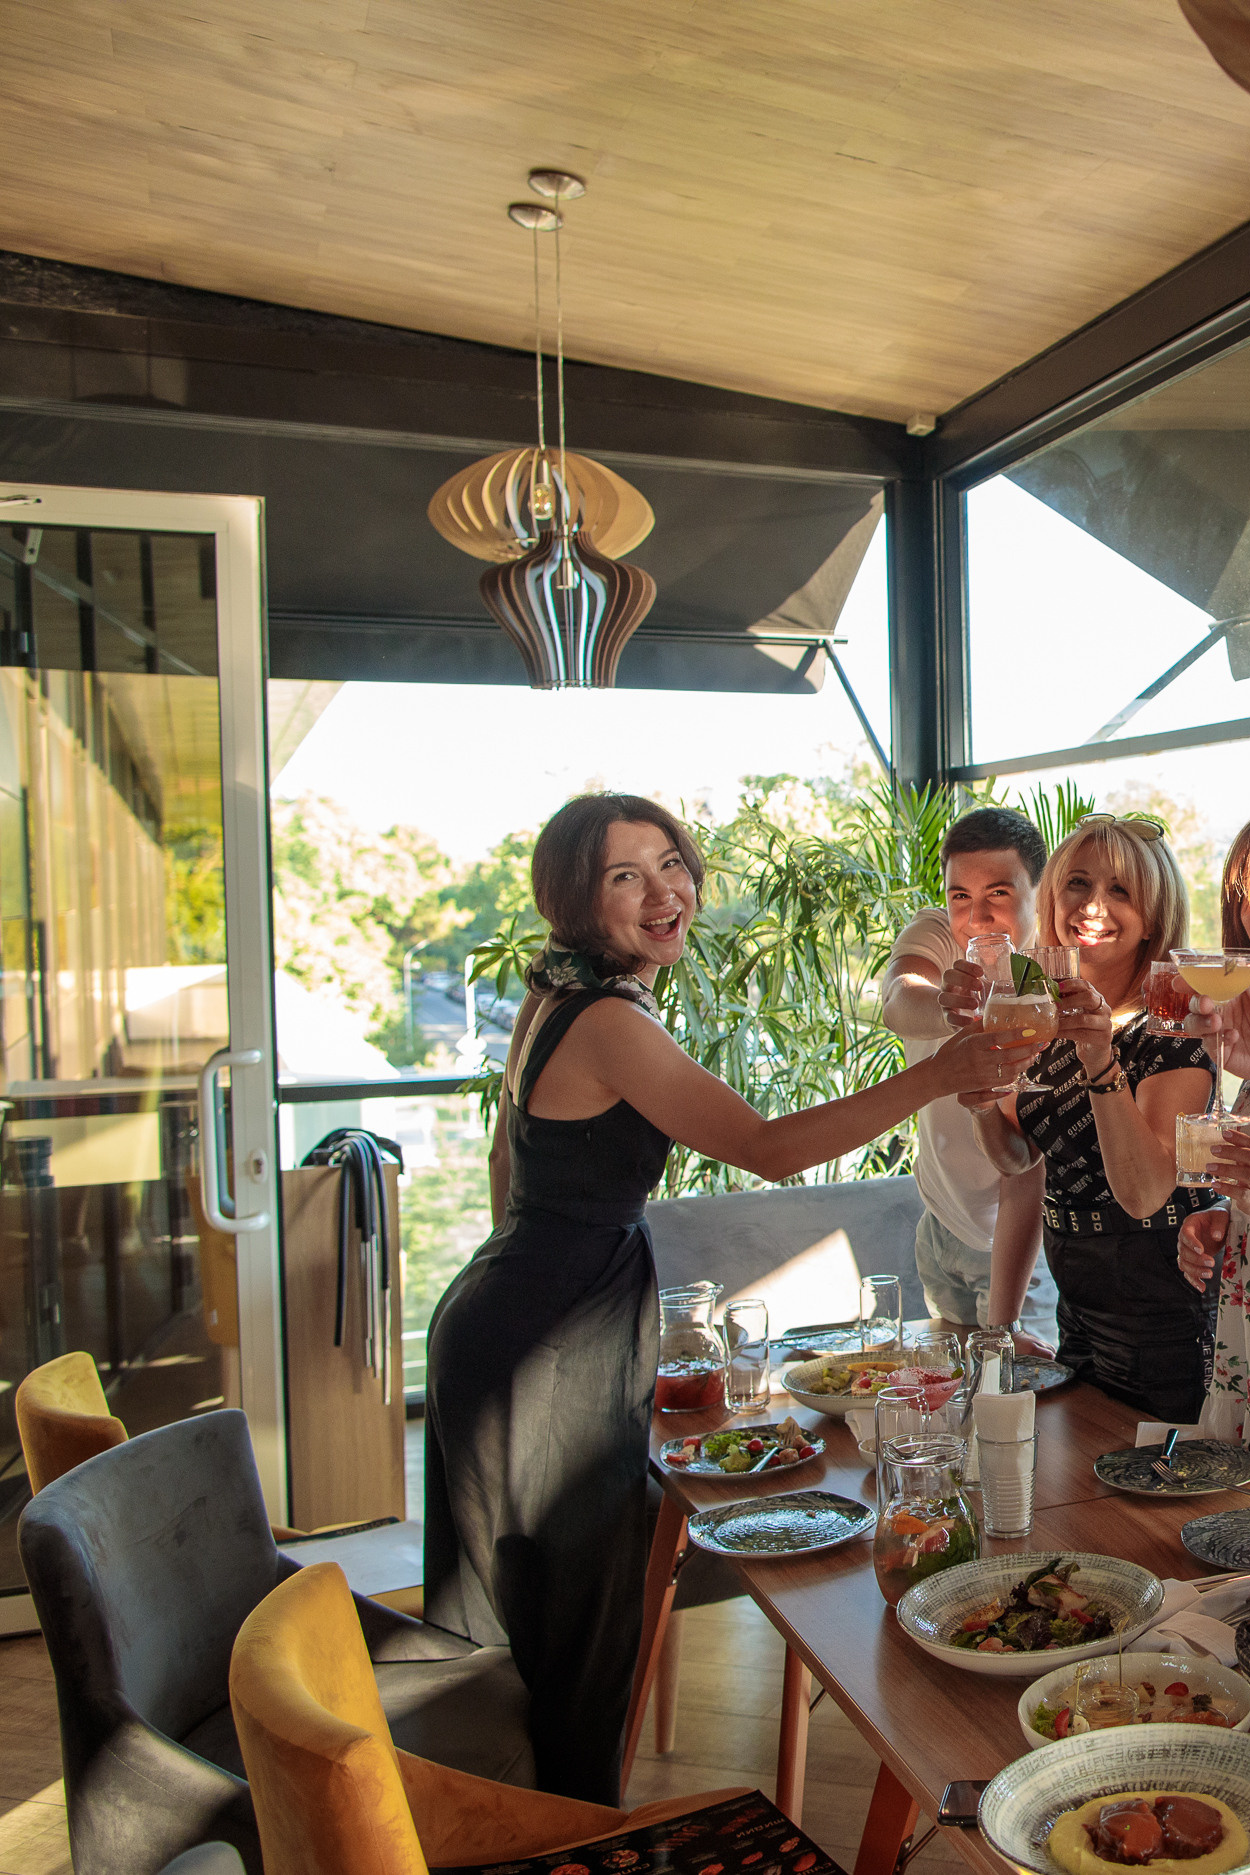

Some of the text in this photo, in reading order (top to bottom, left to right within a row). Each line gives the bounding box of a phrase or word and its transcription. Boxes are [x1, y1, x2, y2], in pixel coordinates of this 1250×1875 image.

[1053, 1076, 1076, 1095] GUESS
[1067, 1112, 1093, 1136] GUESS
[1203, 1358, 1213, 1393] KEND
